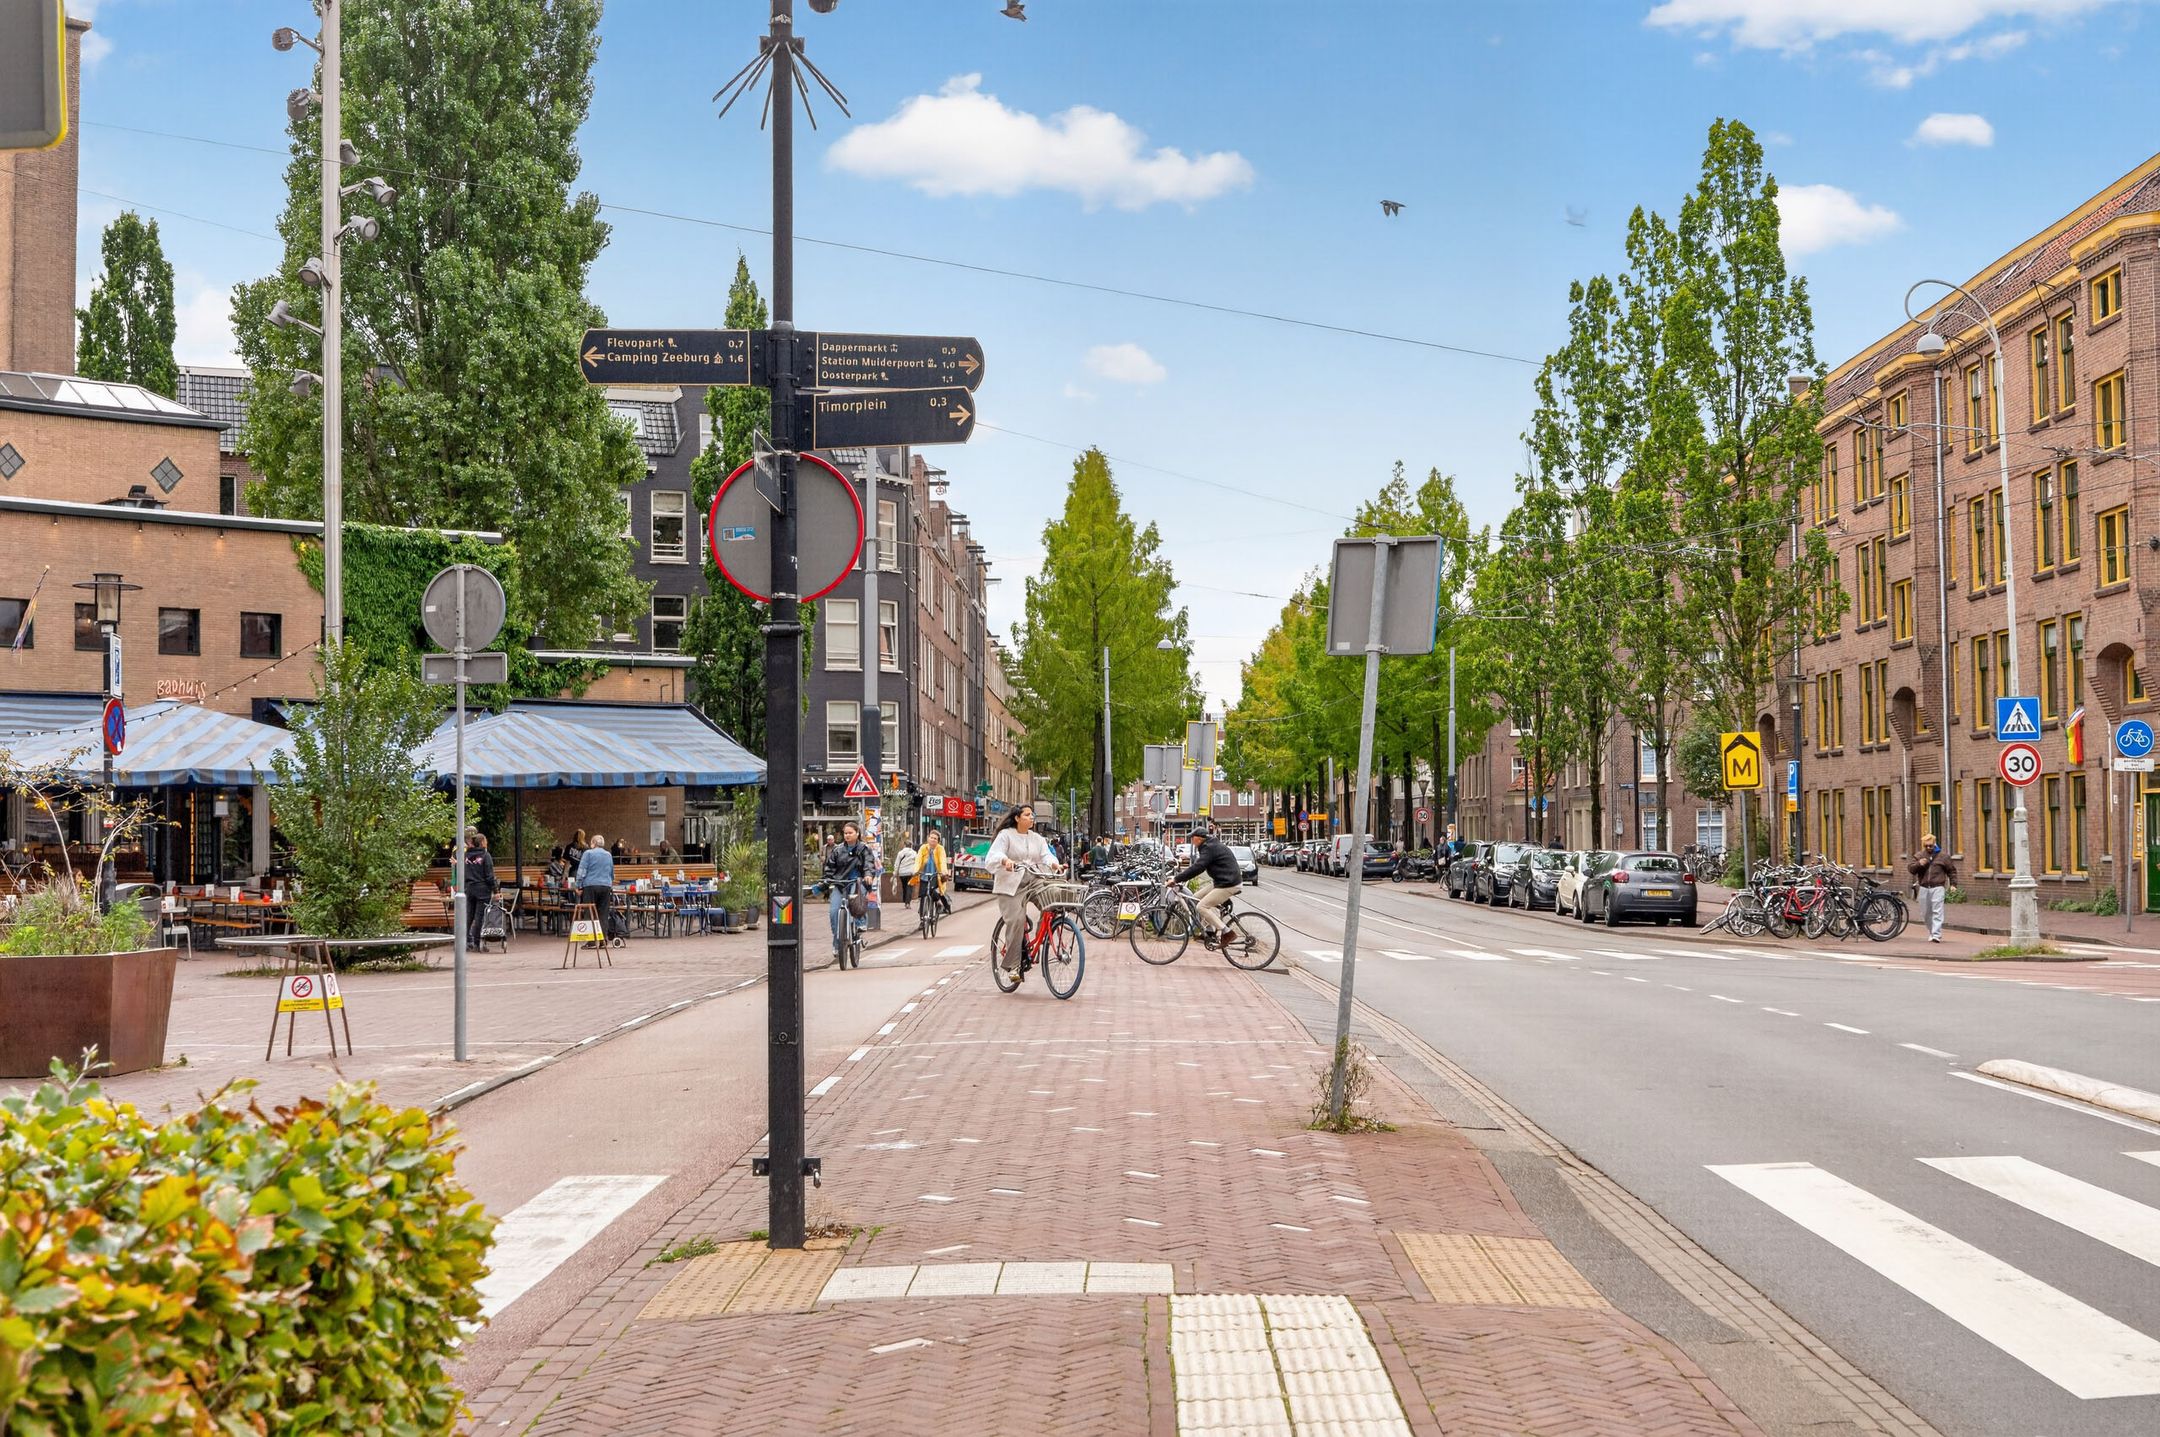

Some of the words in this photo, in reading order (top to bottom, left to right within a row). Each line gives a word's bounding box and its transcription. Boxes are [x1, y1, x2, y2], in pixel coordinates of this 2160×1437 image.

[607, 337, 665, 349] Flevopark
[822, 342, 887, 353] Dappermarkt
[607, 352, 658, 364] Camping
[662, 353, 710, 364] Zeeburg
[822, 356, 858, 366] Station
[861, 358, 925, 369] Muiderpoort
[821, 370, 878, 382] Oosterpark
[818, 398, 887, 413] Timorplein
[1732, 757, 1751, 778] M
[2008, 755, 2035, 773] 30
[1789, 763, 1795, 780] P
